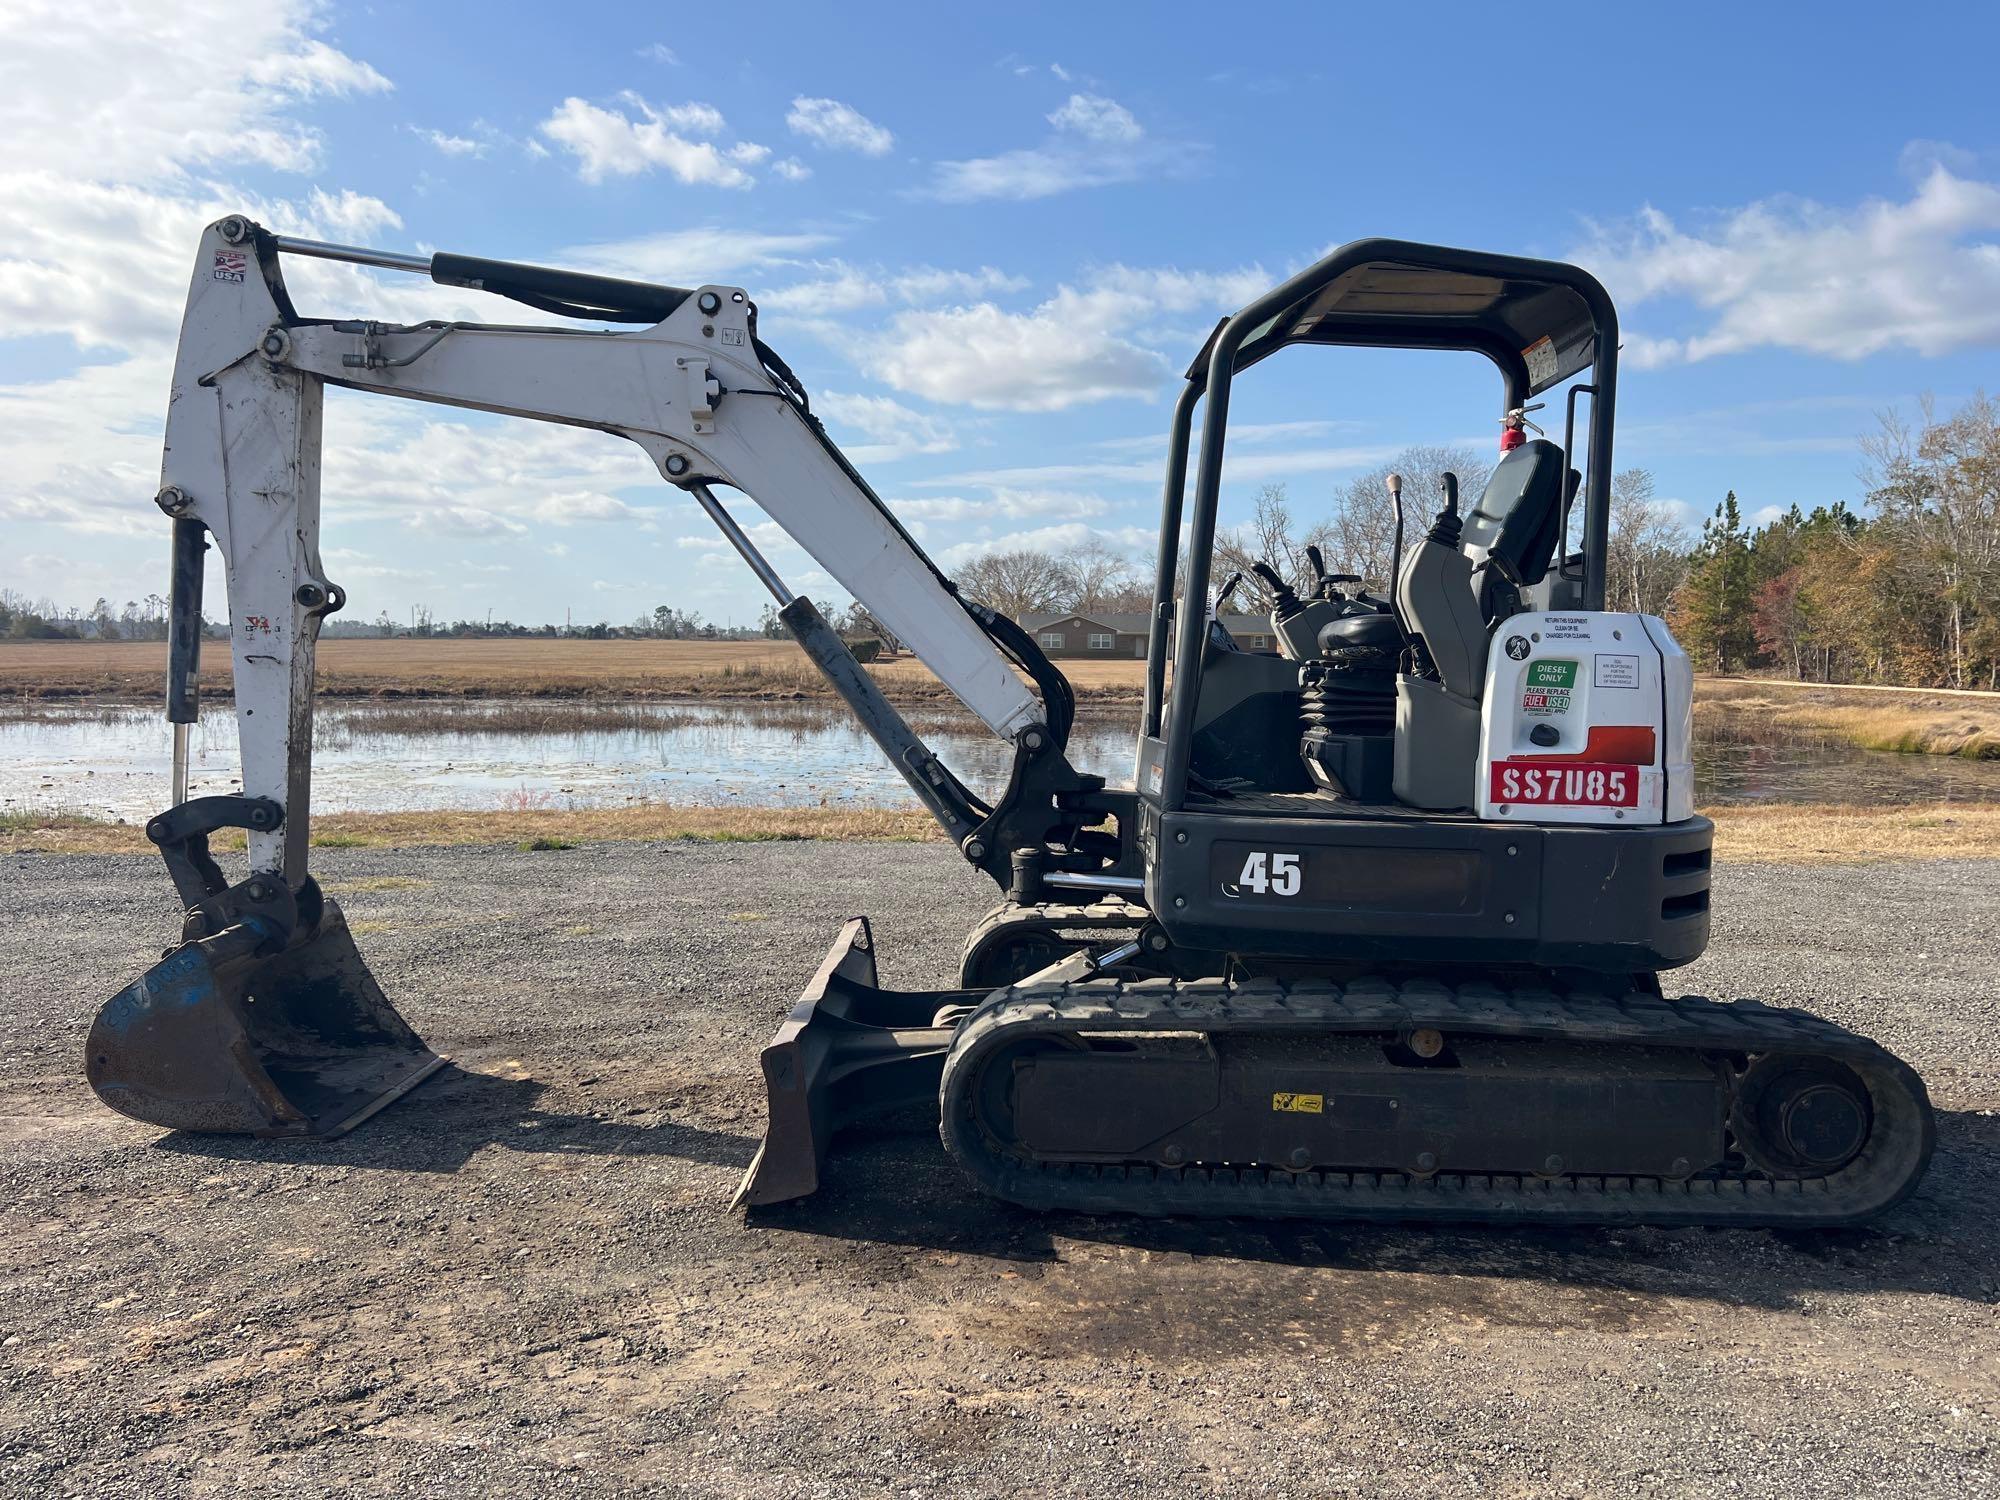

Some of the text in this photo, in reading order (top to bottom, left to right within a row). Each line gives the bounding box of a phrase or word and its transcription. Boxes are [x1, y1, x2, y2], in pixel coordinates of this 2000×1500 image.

[215, 271, 241, 281] USA
[1537, 665, 1567, 673] DIESEL
[1538, 674, 1563, 682] ONLY
[1546, 688, 1570, 696] REPLACE
[1524, 695, 1570, 708] FUEL USED
[1502, 768, 1626, 802] SS7U85
[1239, 852, 1301, 896] 45
